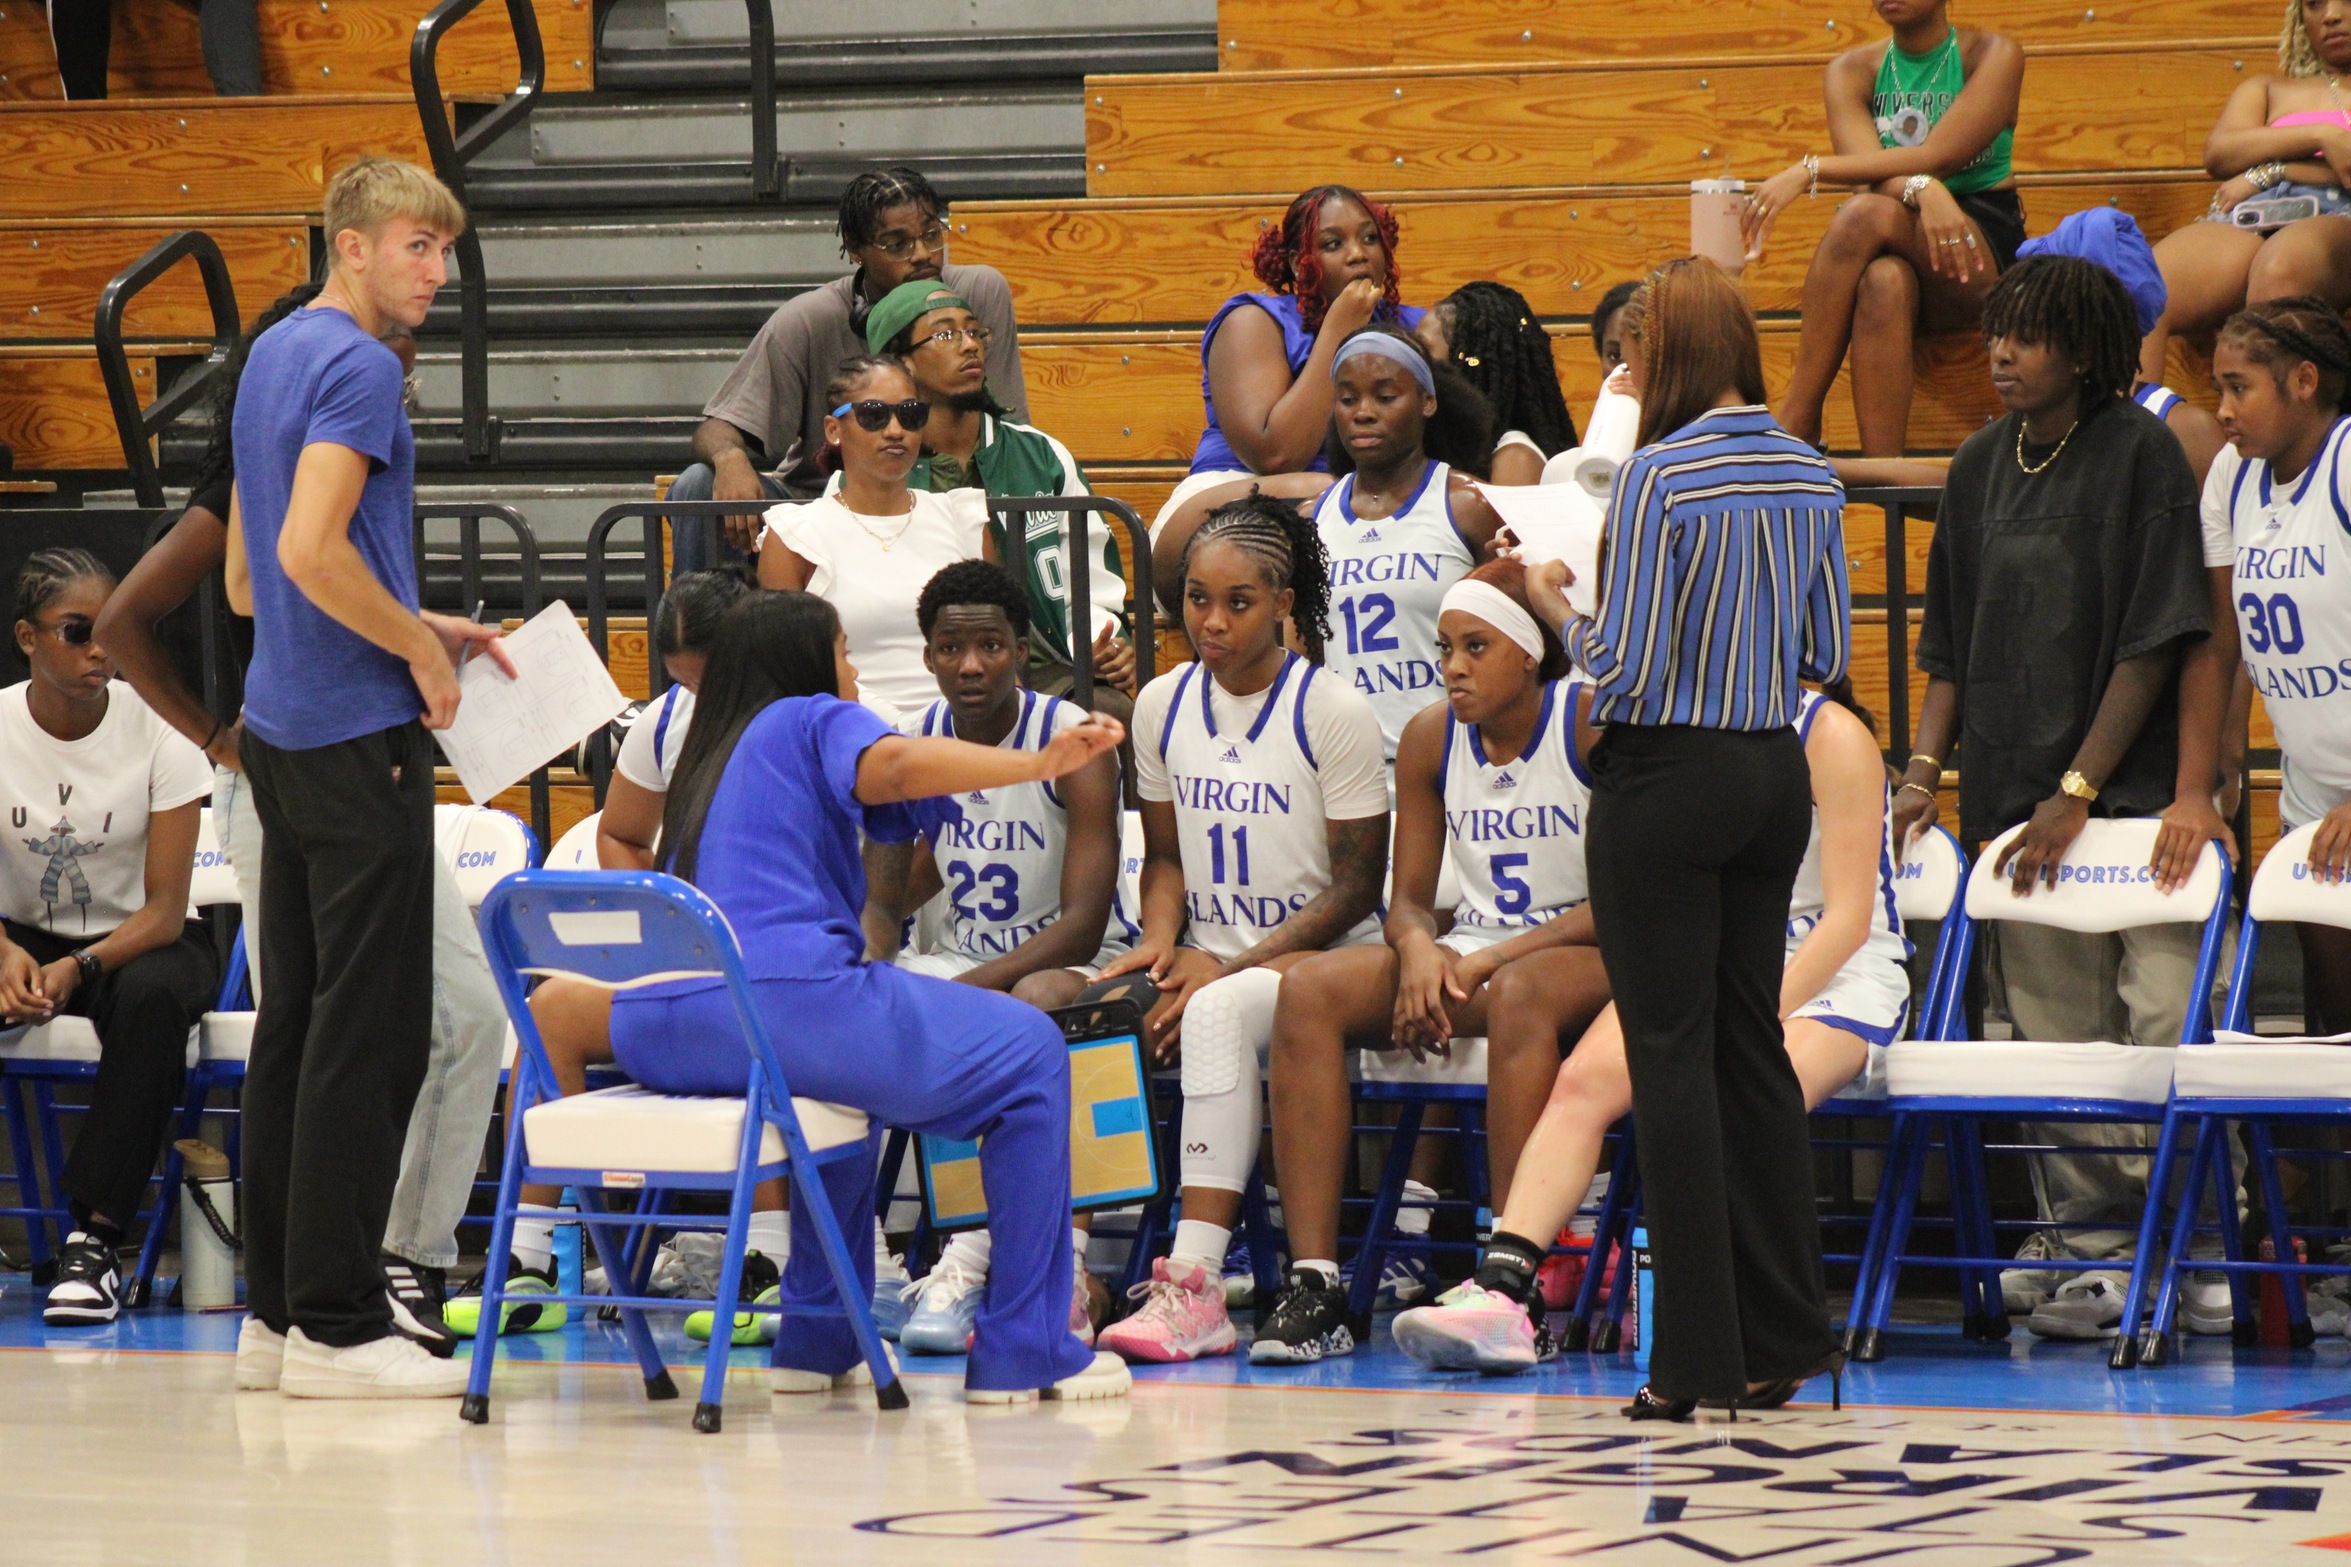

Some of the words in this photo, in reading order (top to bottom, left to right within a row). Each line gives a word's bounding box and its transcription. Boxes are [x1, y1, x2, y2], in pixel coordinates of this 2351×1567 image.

[1358, 536, 1382, 544] adidas
[1329, 552, 1442, 588] IRGIN
[2233, 544, 2326, 580] IRGIN
[1338, 592, 1399, 655] 12
[2238, 592, 2305, 655] 30
[1218, 756, 1242, 764] adidas
[1173, 774, 1292, 815] VIRGIN
[1492, 781, 1517, 790] adidas
[946, 817, 1046, 851] IRGIN
[1446, 804, 1580, 841] VIRGIN
[1207, 822, 1250, 886] 11
[947, 859, 1019, 922] 23
[1489, 852, 1532, 915] 5
[1308, 1428, 2351, 1477] SLANDS
